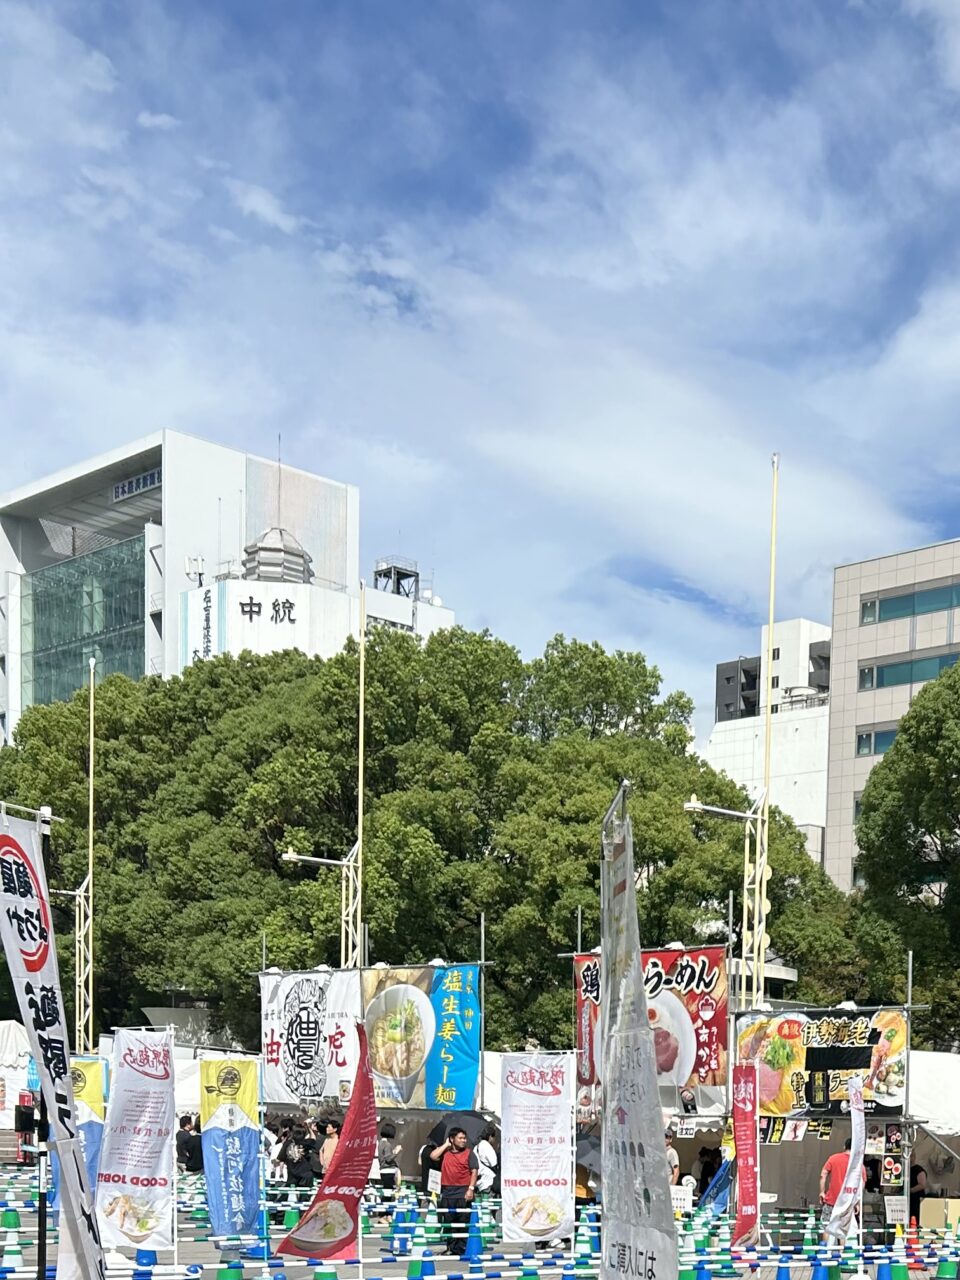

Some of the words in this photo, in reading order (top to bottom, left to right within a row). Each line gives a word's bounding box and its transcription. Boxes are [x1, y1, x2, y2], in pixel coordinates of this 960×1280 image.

[239, 596, 297, 624] 中統
[643, 956, 720, 998] らーめん
[328, 1022, 348, 1068] 虎
[434, 969, 463, 1106] 塩生姜らー麺
[698, 1024, 710, 1083] あかぎ
[801, 1017, 871, 1046] 伊勢海老
